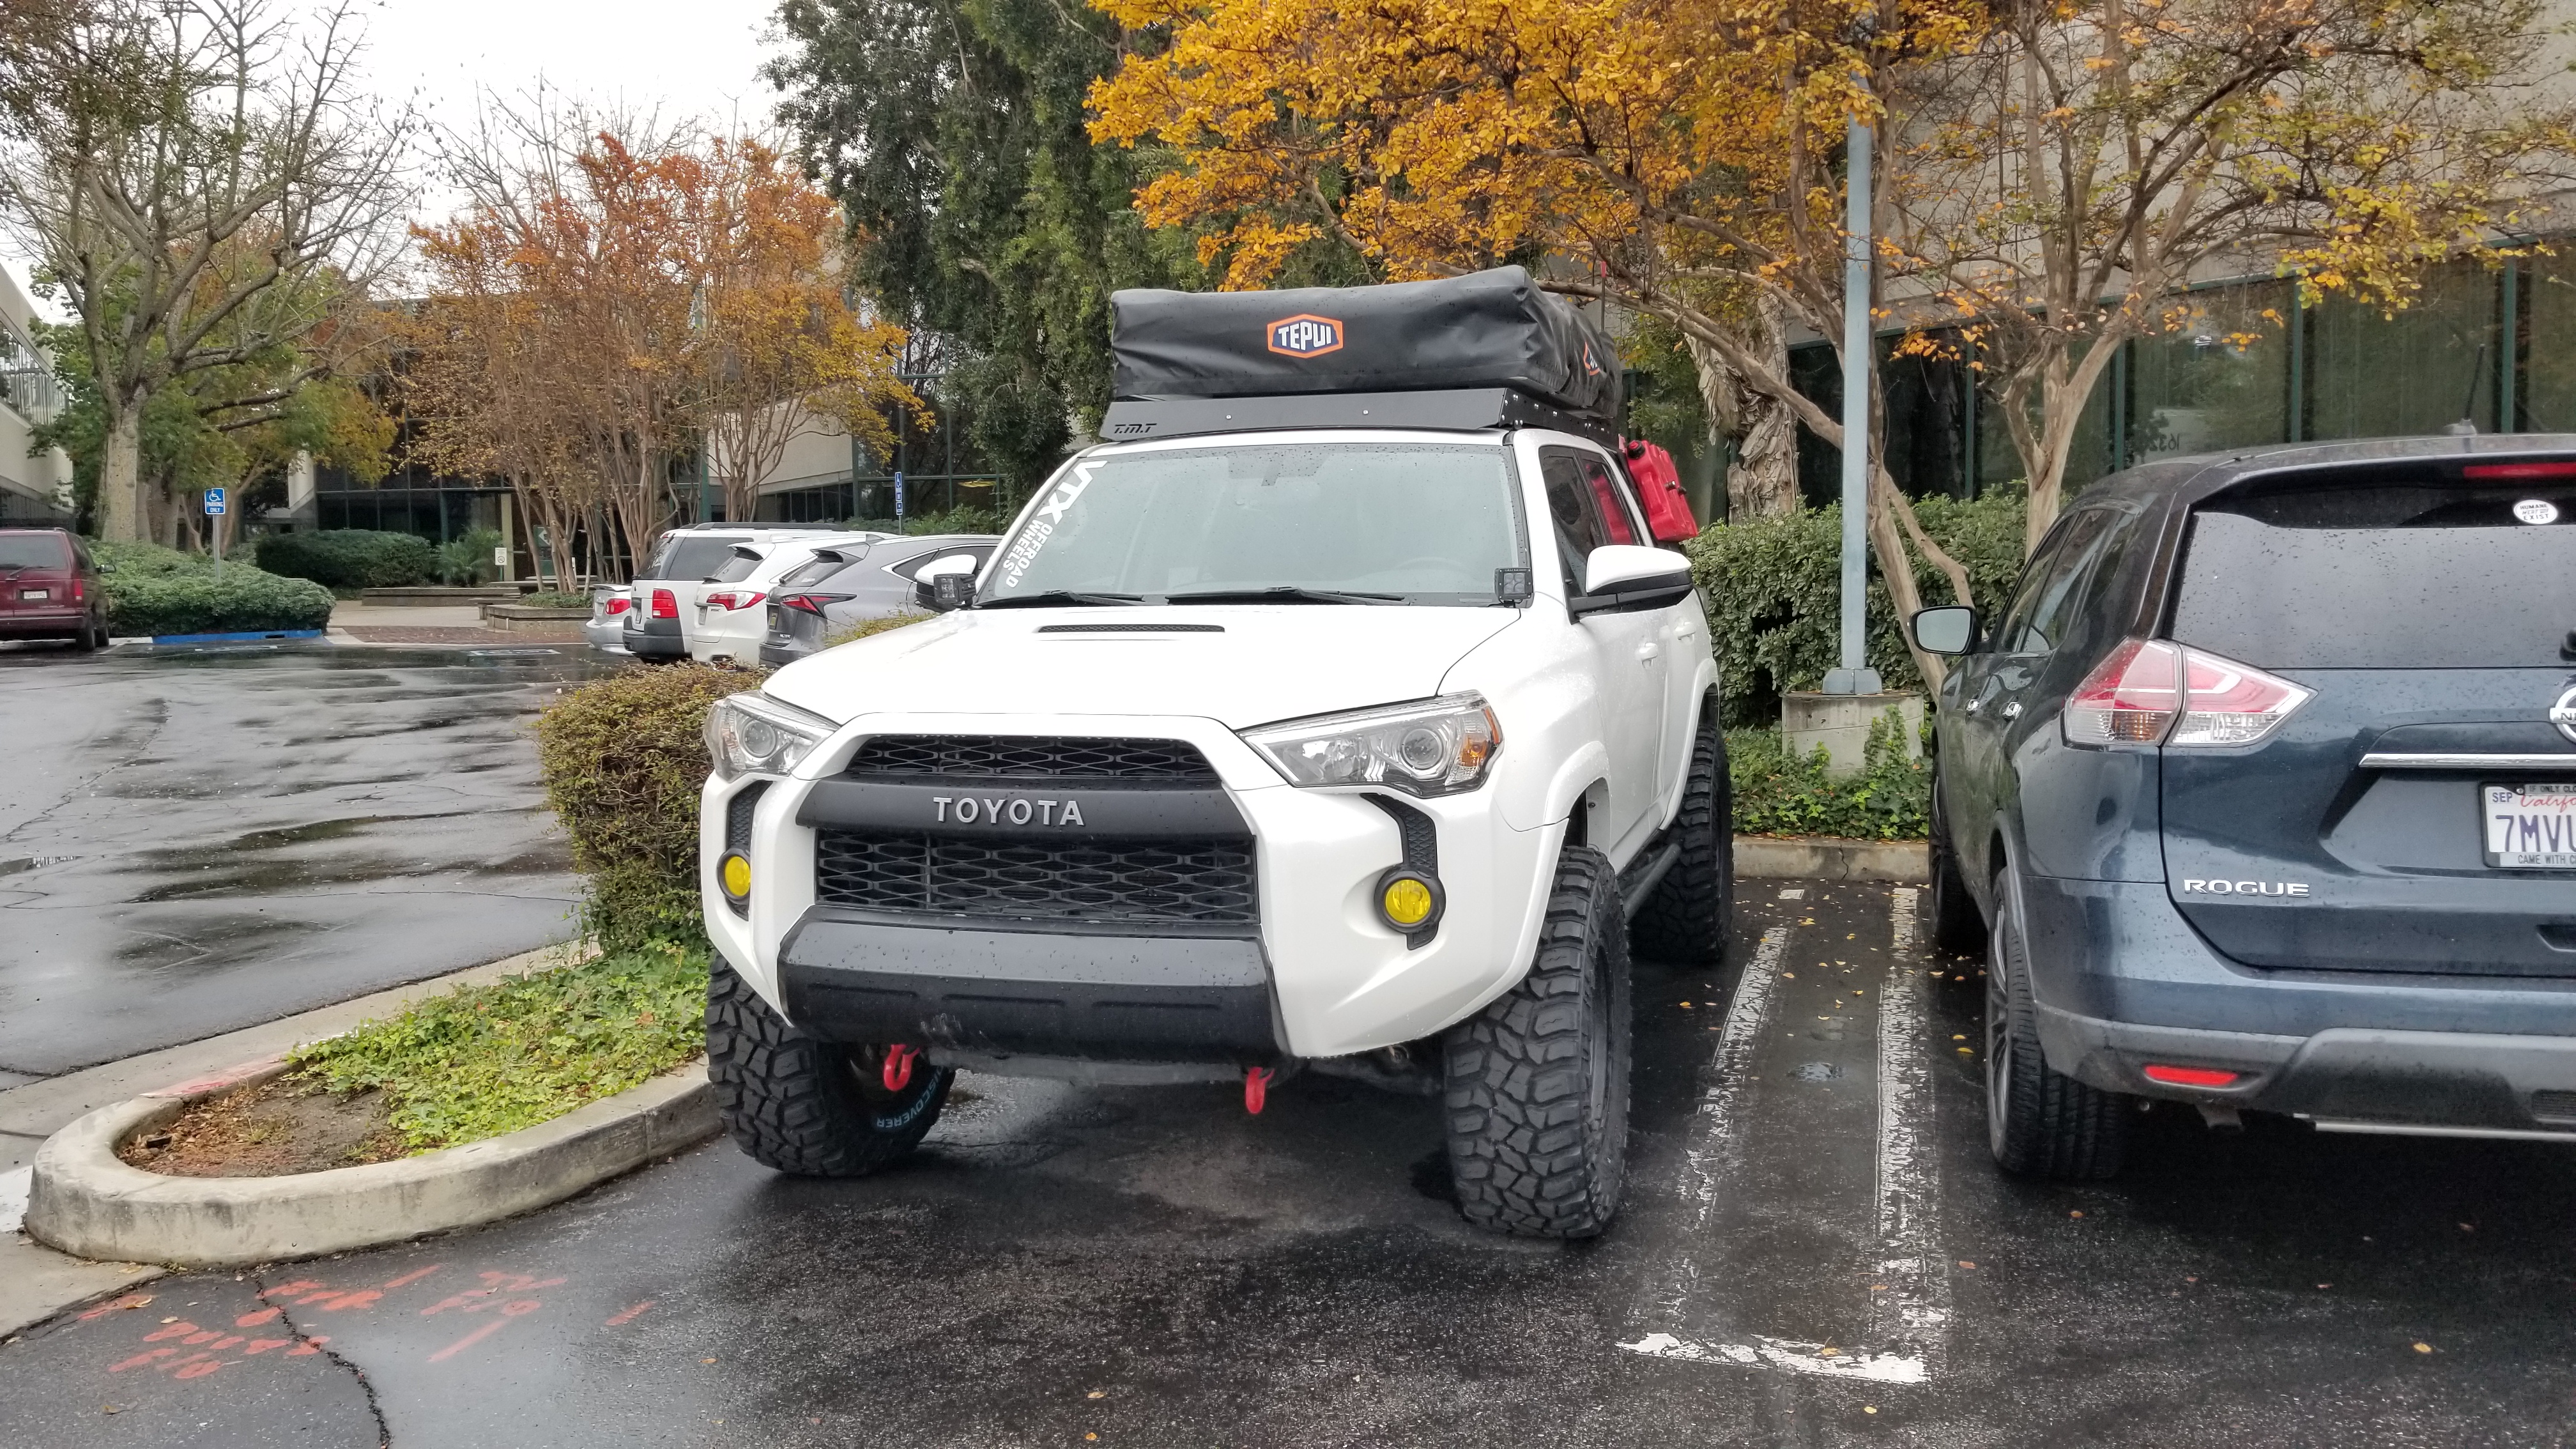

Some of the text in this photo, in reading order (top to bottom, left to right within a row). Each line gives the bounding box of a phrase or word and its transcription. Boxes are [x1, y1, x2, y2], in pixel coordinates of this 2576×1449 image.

[1278, 321, 1332, 351] TEPUI
[1114, 423, 1158, 434] T.M.T
[1037, 460, 1108, 525] VTX
[1003, 519, 1044, 571] WHEELS
[1006, 523, 1053, 588] OFFROAD
[933, 797, 1085, 826] TOYOTA
[2492, 792, 2513, 803] SEP
[2518, 855, 2541, 864] CAME
[2545, 855, 2566, 864] WITH
[2184, 879, 2310, 898] ROGUE
